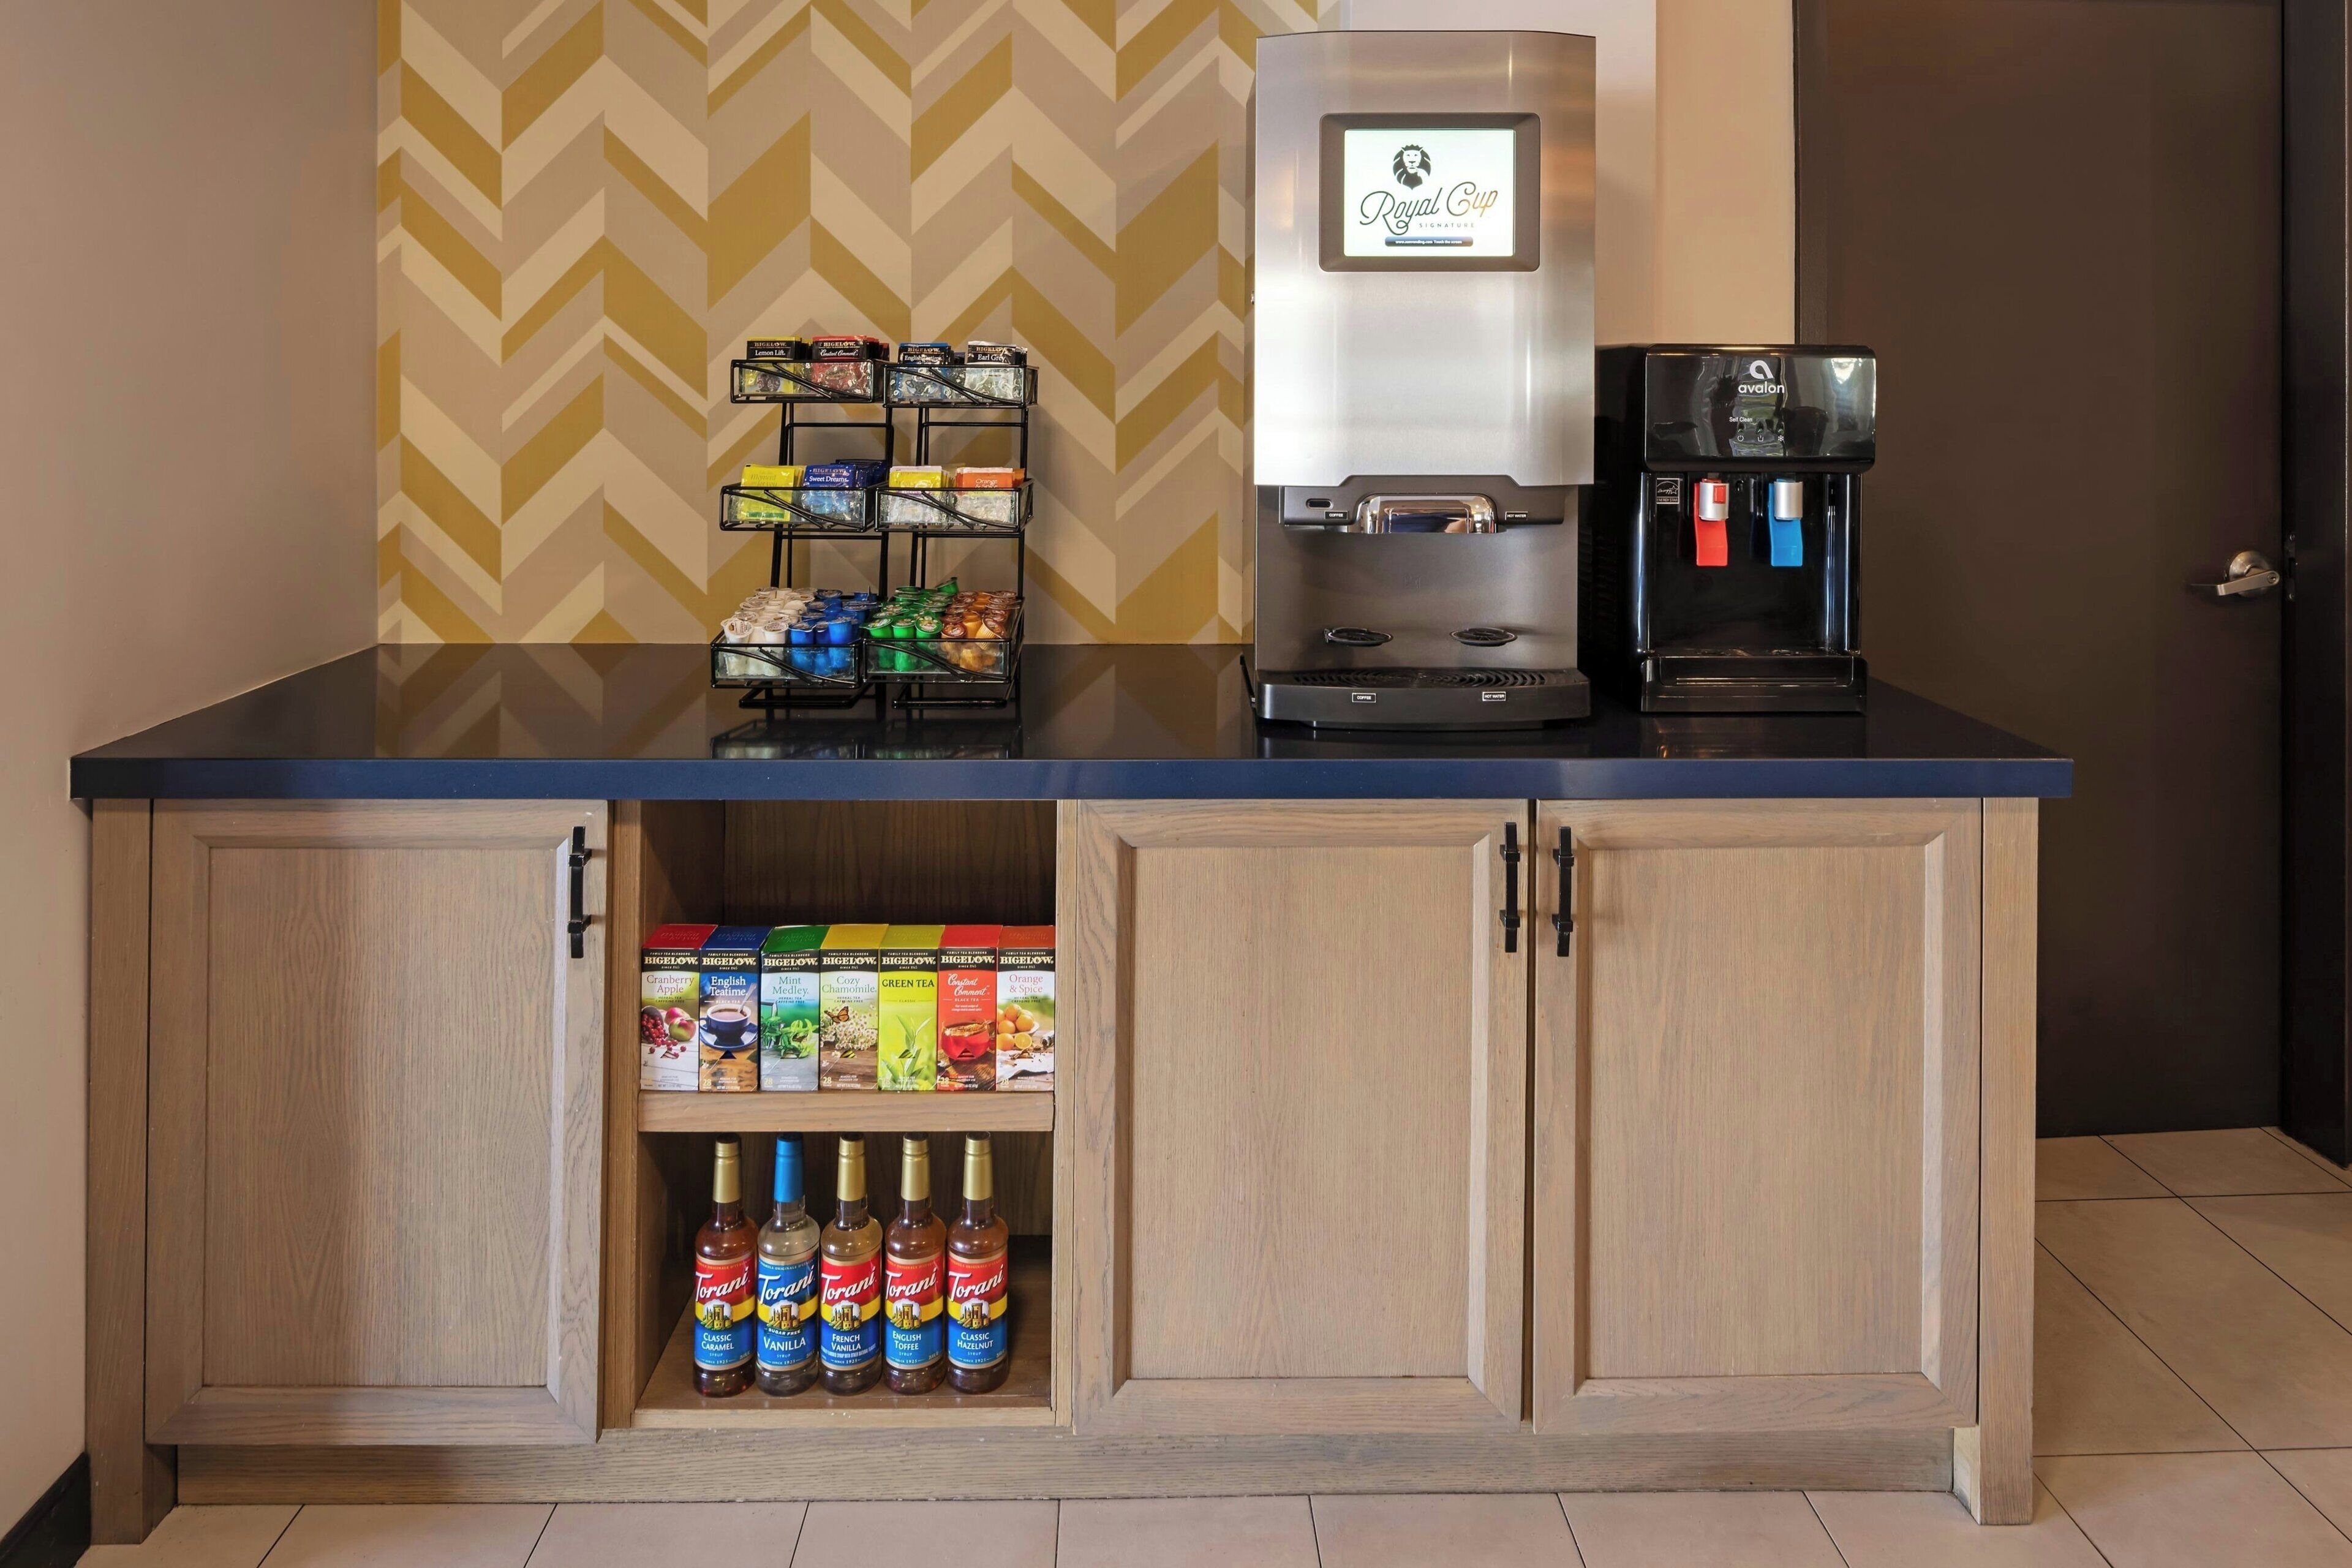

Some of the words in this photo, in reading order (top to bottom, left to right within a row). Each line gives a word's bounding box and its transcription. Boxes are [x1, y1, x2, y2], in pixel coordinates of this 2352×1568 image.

[1359, 187, 1442, 235] Royal
[1446, 181, 1498, 217] Cup
[1738, 381, 1785, 393] avalon
[647, 975, 694, 986] Cranberry
[711, 976, 746, 988] English
[837, 976, 860, 987] Cozy
[1009, 974, 1043, 984] Orange
[657, 984, 684, 995] Apple
[710, 987, 746, 996] Teatime
[772, 986, 808, 997] Medley
[822, 984, 875, 993] Chamomile
[1019, 984, 1042, 995] Spice
[696, 1267, 748, 1302] Torani
[759, 1265, 814, 1303] Torani
[821, 1266, 875, 1303] Torani
[886, 1267, 937, 1299] Torani
[949, 1264, 1003, 1302] Torani
[703, 1333, 731, 1342] CLASSIC
[832, 1333, 860, 1342] FRENCH
[892, 1330, 921, 1341] ENGLISH
[961, 1332, 989, 1341] CLASSIC
[701, 1341, 734, 1351] CARAMEL
[764, 1336, 805, 1351] VANILLA
[831, 1342, 861, 1351] VANILLA
[894, 1340, 919, 1350] TOFFEE
[957, 1339, 993, 1349] HAZELNUT
